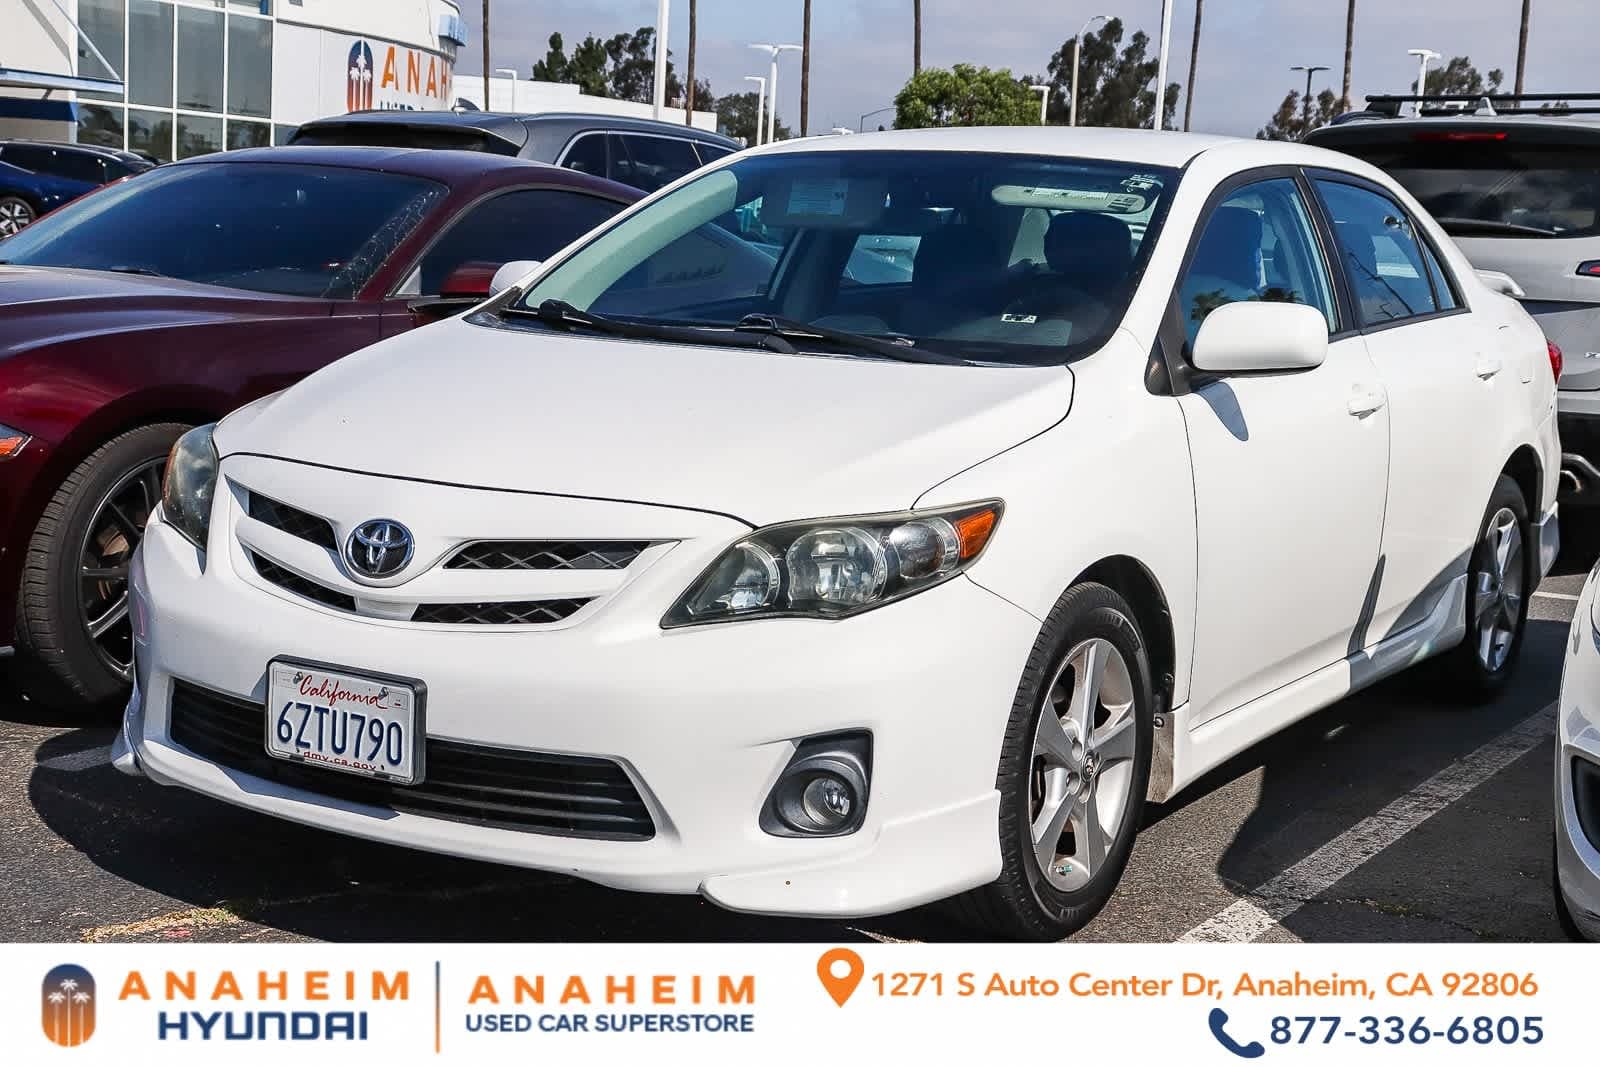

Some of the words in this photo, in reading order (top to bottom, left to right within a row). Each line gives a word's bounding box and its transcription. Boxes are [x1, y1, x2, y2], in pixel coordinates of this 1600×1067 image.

[300, 675, 388, 709] California
[277, 702, 403, 766] 6ZTU790
[303, 751, 377, 772] dmv.ca.gov
